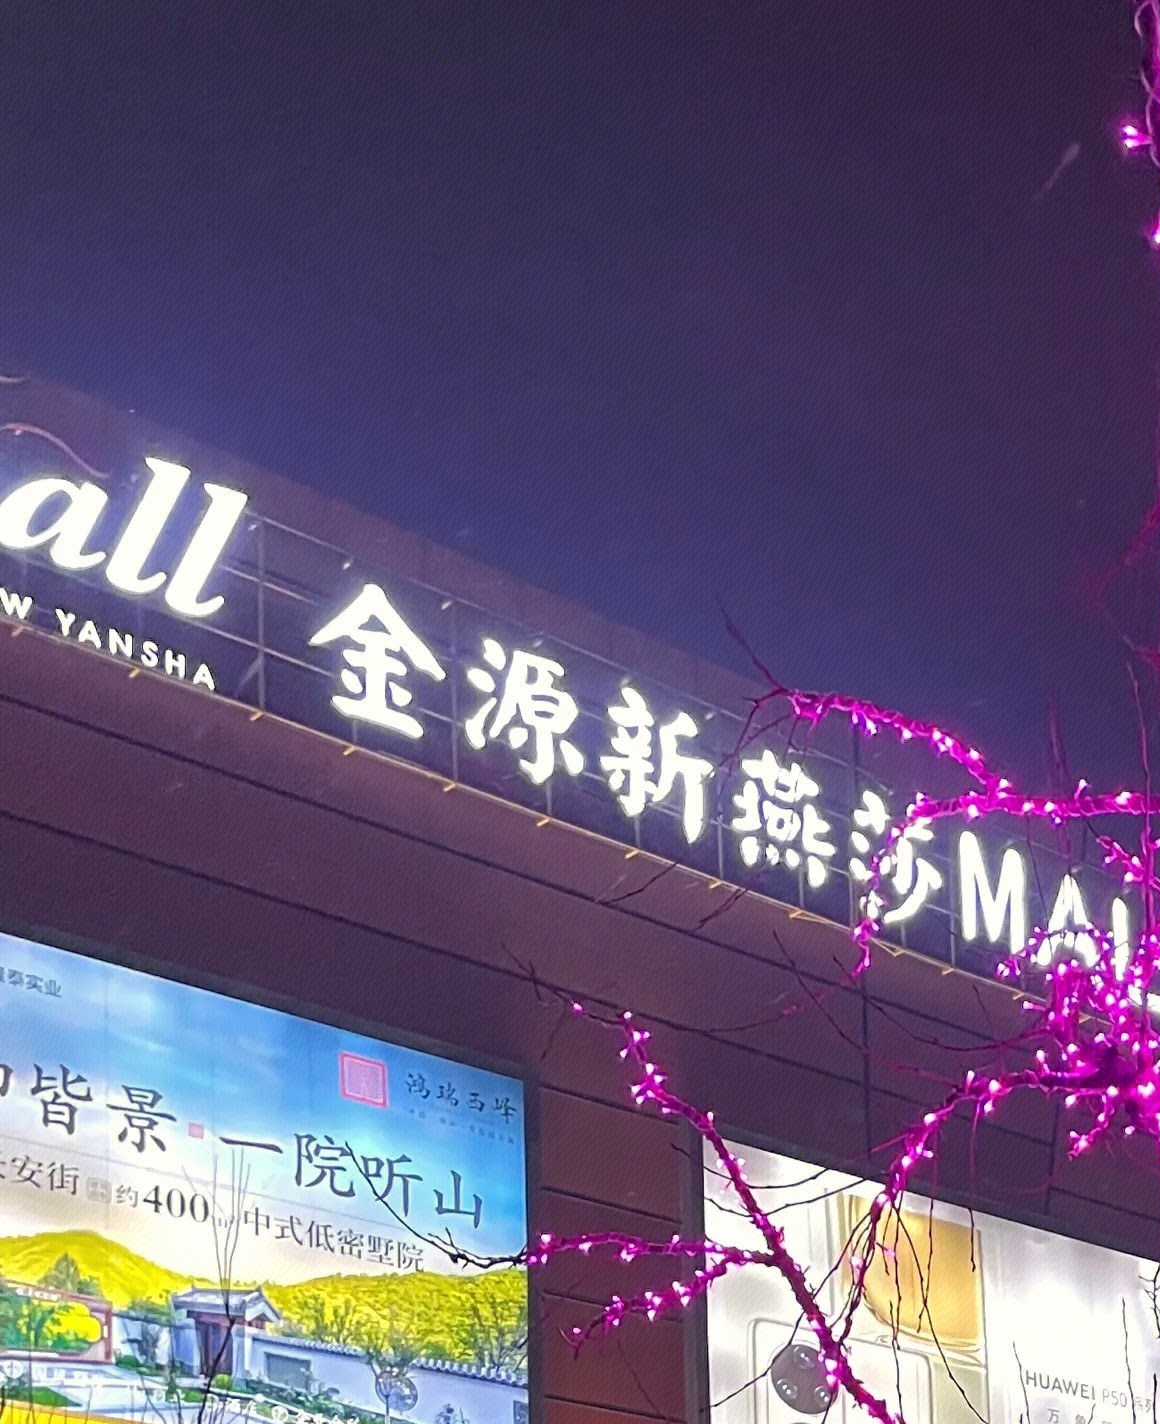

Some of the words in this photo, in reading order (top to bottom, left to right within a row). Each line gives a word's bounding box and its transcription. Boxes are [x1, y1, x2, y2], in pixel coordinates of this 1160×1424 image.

[0, 457, 248, 618] all
[55, 608, 216, 691] YANSHA
[219, 1133, 483, 1229] 一院听山
[243, 1206, 425, 1273] 中式低密墅院
[1025, 1369, 1096, 1401] HUAWEI
